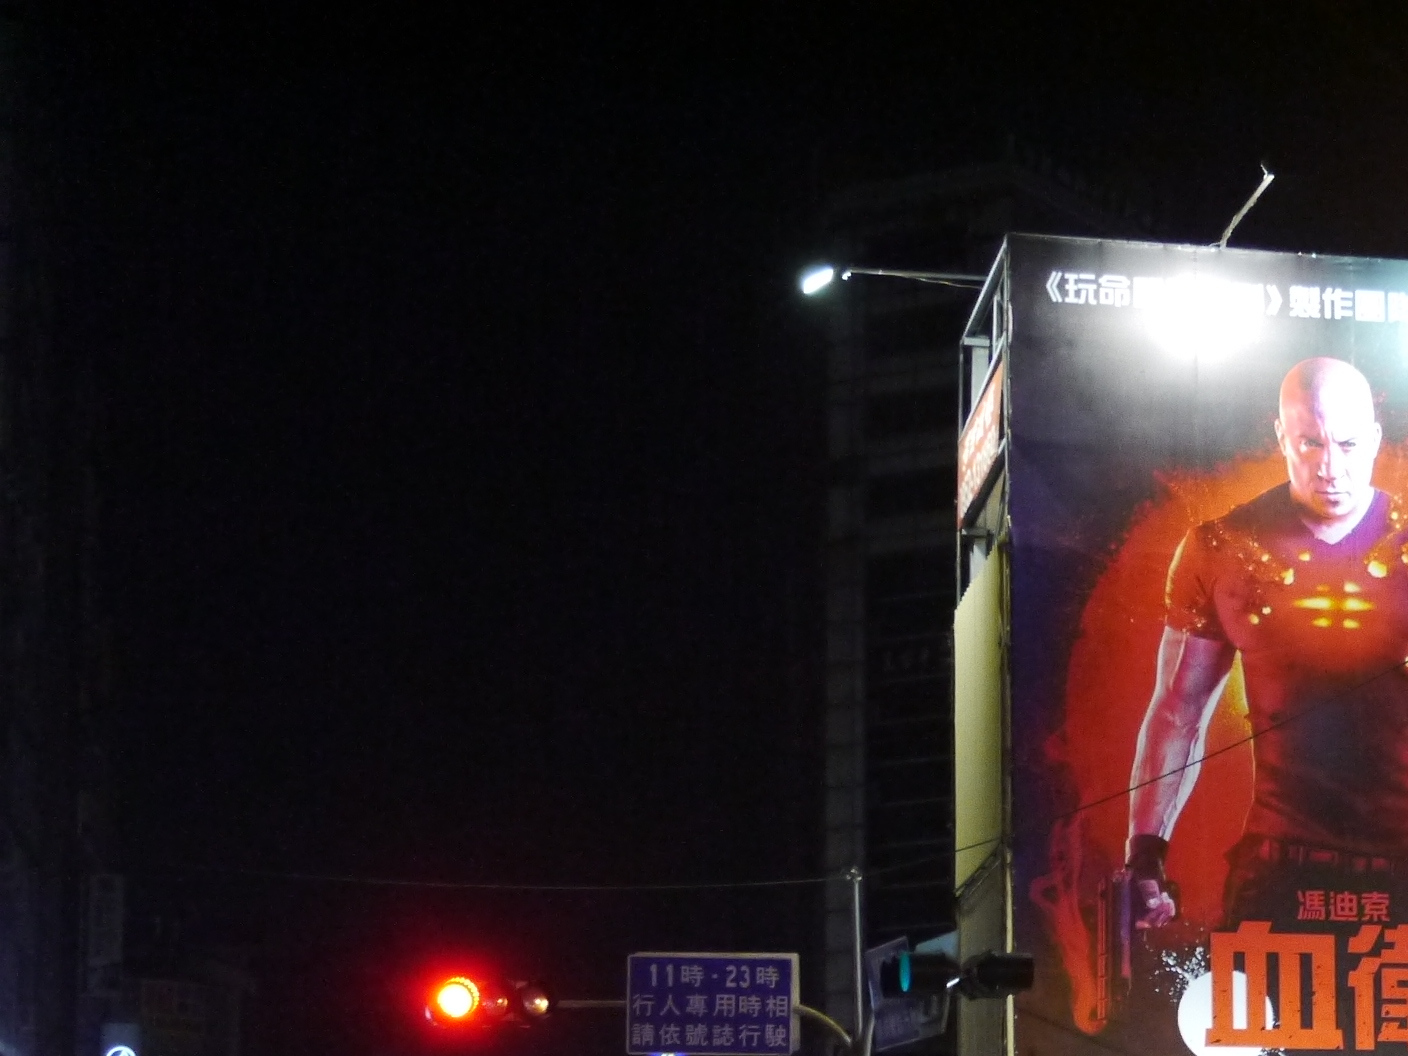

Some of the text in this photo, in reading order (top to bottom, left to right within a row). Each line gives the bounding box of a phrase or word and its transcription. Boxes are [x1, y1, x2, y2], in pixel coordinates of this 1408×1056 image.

[1298, 891, 1390, 923] 馮迪索
[632, 993, 788, 1018] 行人專用時相
[631, 1023, 787, 1047] 請依號誌行駛
